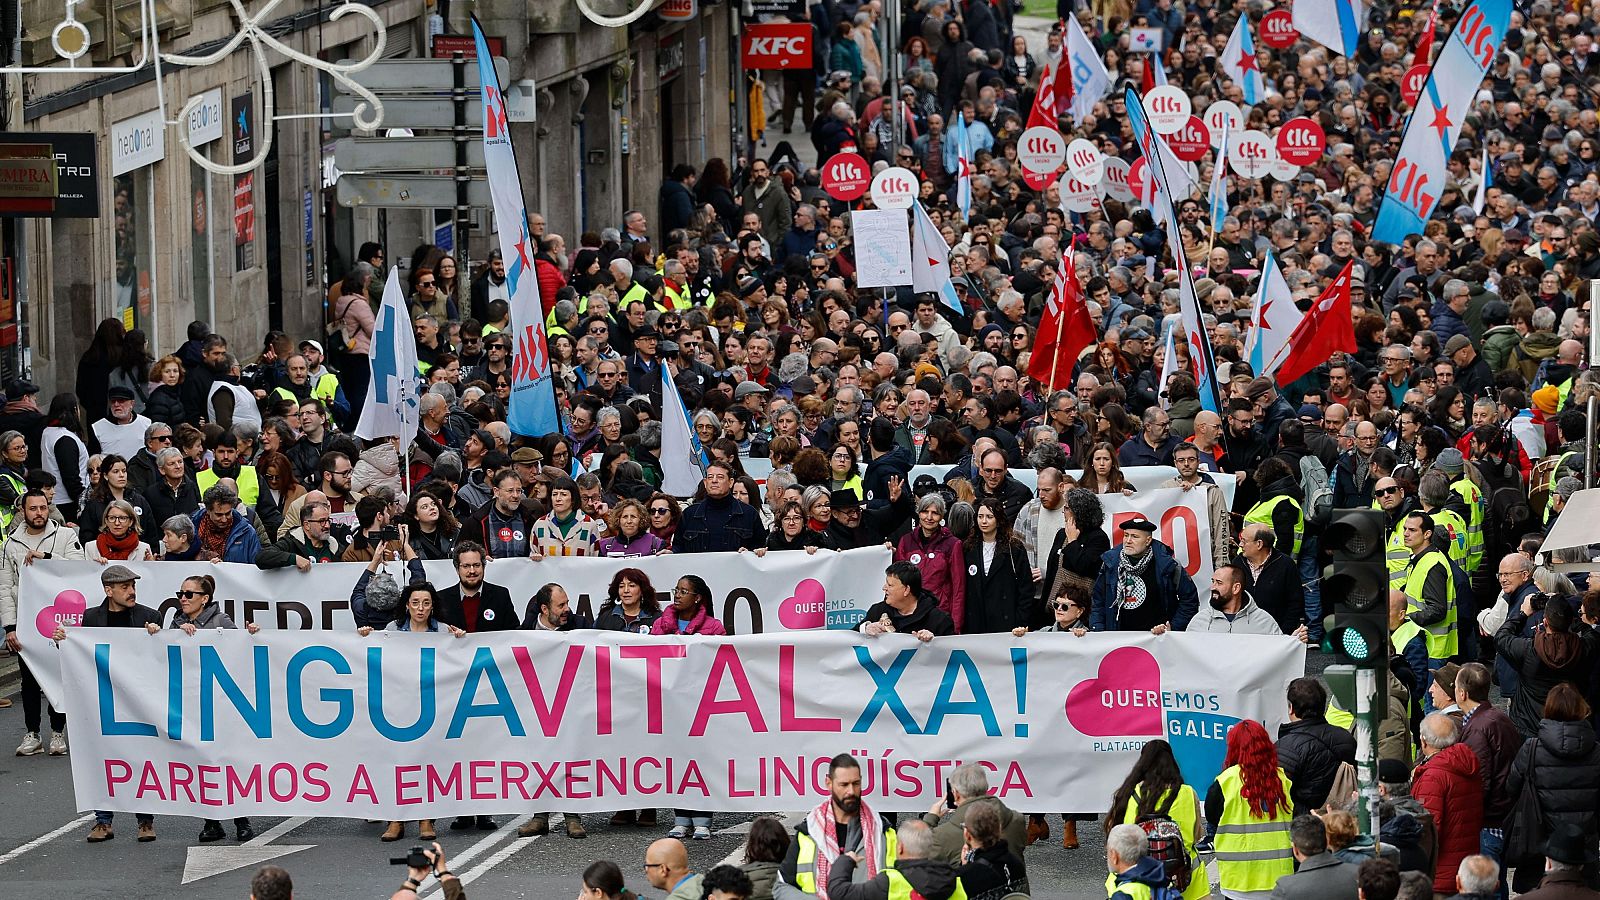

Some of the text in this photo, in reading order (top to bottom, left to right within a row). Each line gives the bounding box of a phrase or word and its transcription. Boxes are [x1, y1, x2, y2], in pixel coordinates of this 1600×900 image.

[1268, 18, 1293, 33] CIG
[748, 37, 805, 55] KFC
[1460, 5, 1494, 69] CIG
[1409, 74, 1427, 91] CI
[1152, 97, 1181, 113] CIG
[117, 121, 155, 158] hedonai
[1027, 137, 1057, 154] CIG
[1286, 128, 1317, 147] CIG
[1073, 149, 1096, 168] CIG
[1239, 142, 1267, 159] CIG
[831, 163, 862, 182] CIG
[881, 178, 910, 194] CIG
[1389, 157, 1435, 220] CIG
[1101, 689, 1220, 711] QUEREMOS
[1169, 719, 1235, 740] GALE
[105, 748, 1033, 806] PAREMOS A EMERXENCIA LINGÜÍSTCA
